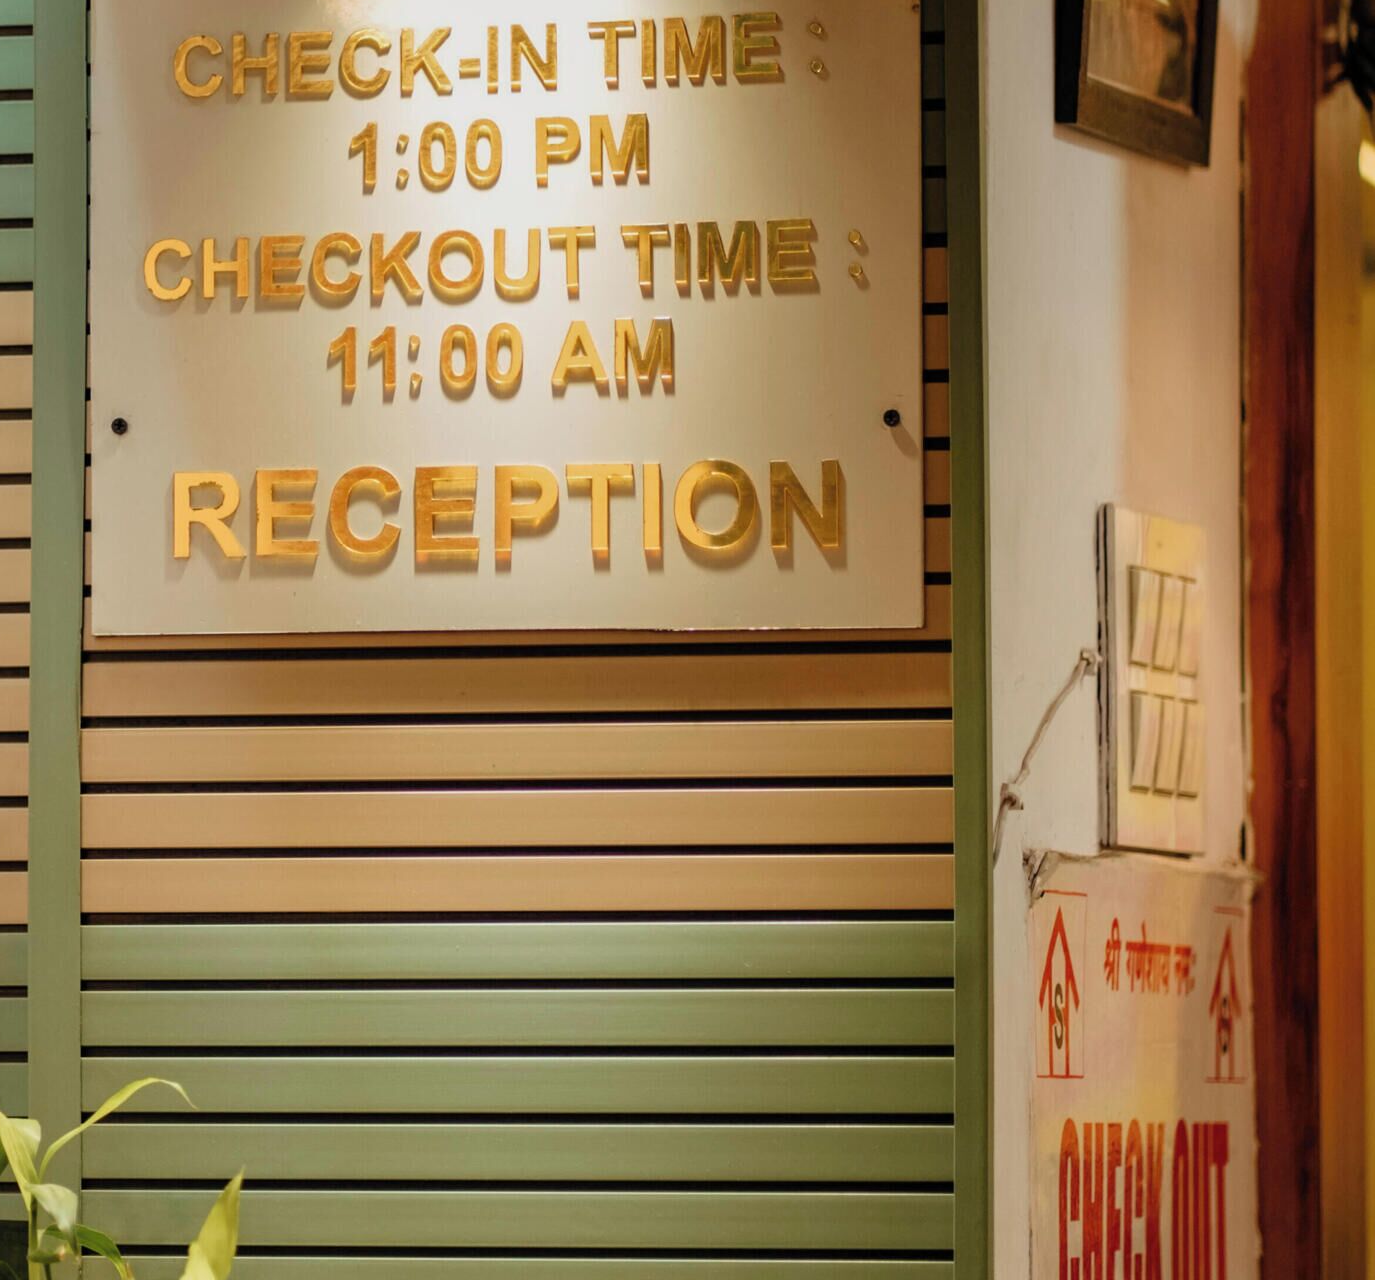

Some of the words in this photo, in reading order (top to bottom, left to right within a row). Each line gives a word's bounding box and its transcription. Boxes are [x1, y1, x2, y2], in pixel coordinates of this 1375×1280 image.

[173, 22, 559, 98] CHECK-IN
[587, 12, 785, 90] TIME
[348, 117, 504, 192] 1:00
[536, 112, 650, 187] PM
[143, 223, 597, 303] CHECKOUT
[621, 218, 818, 296] TIME
[326, 320, 525, 404] 11:00
[551, 316, 674, 393] AM
[172, 459, 846, 569] RECEPTION
